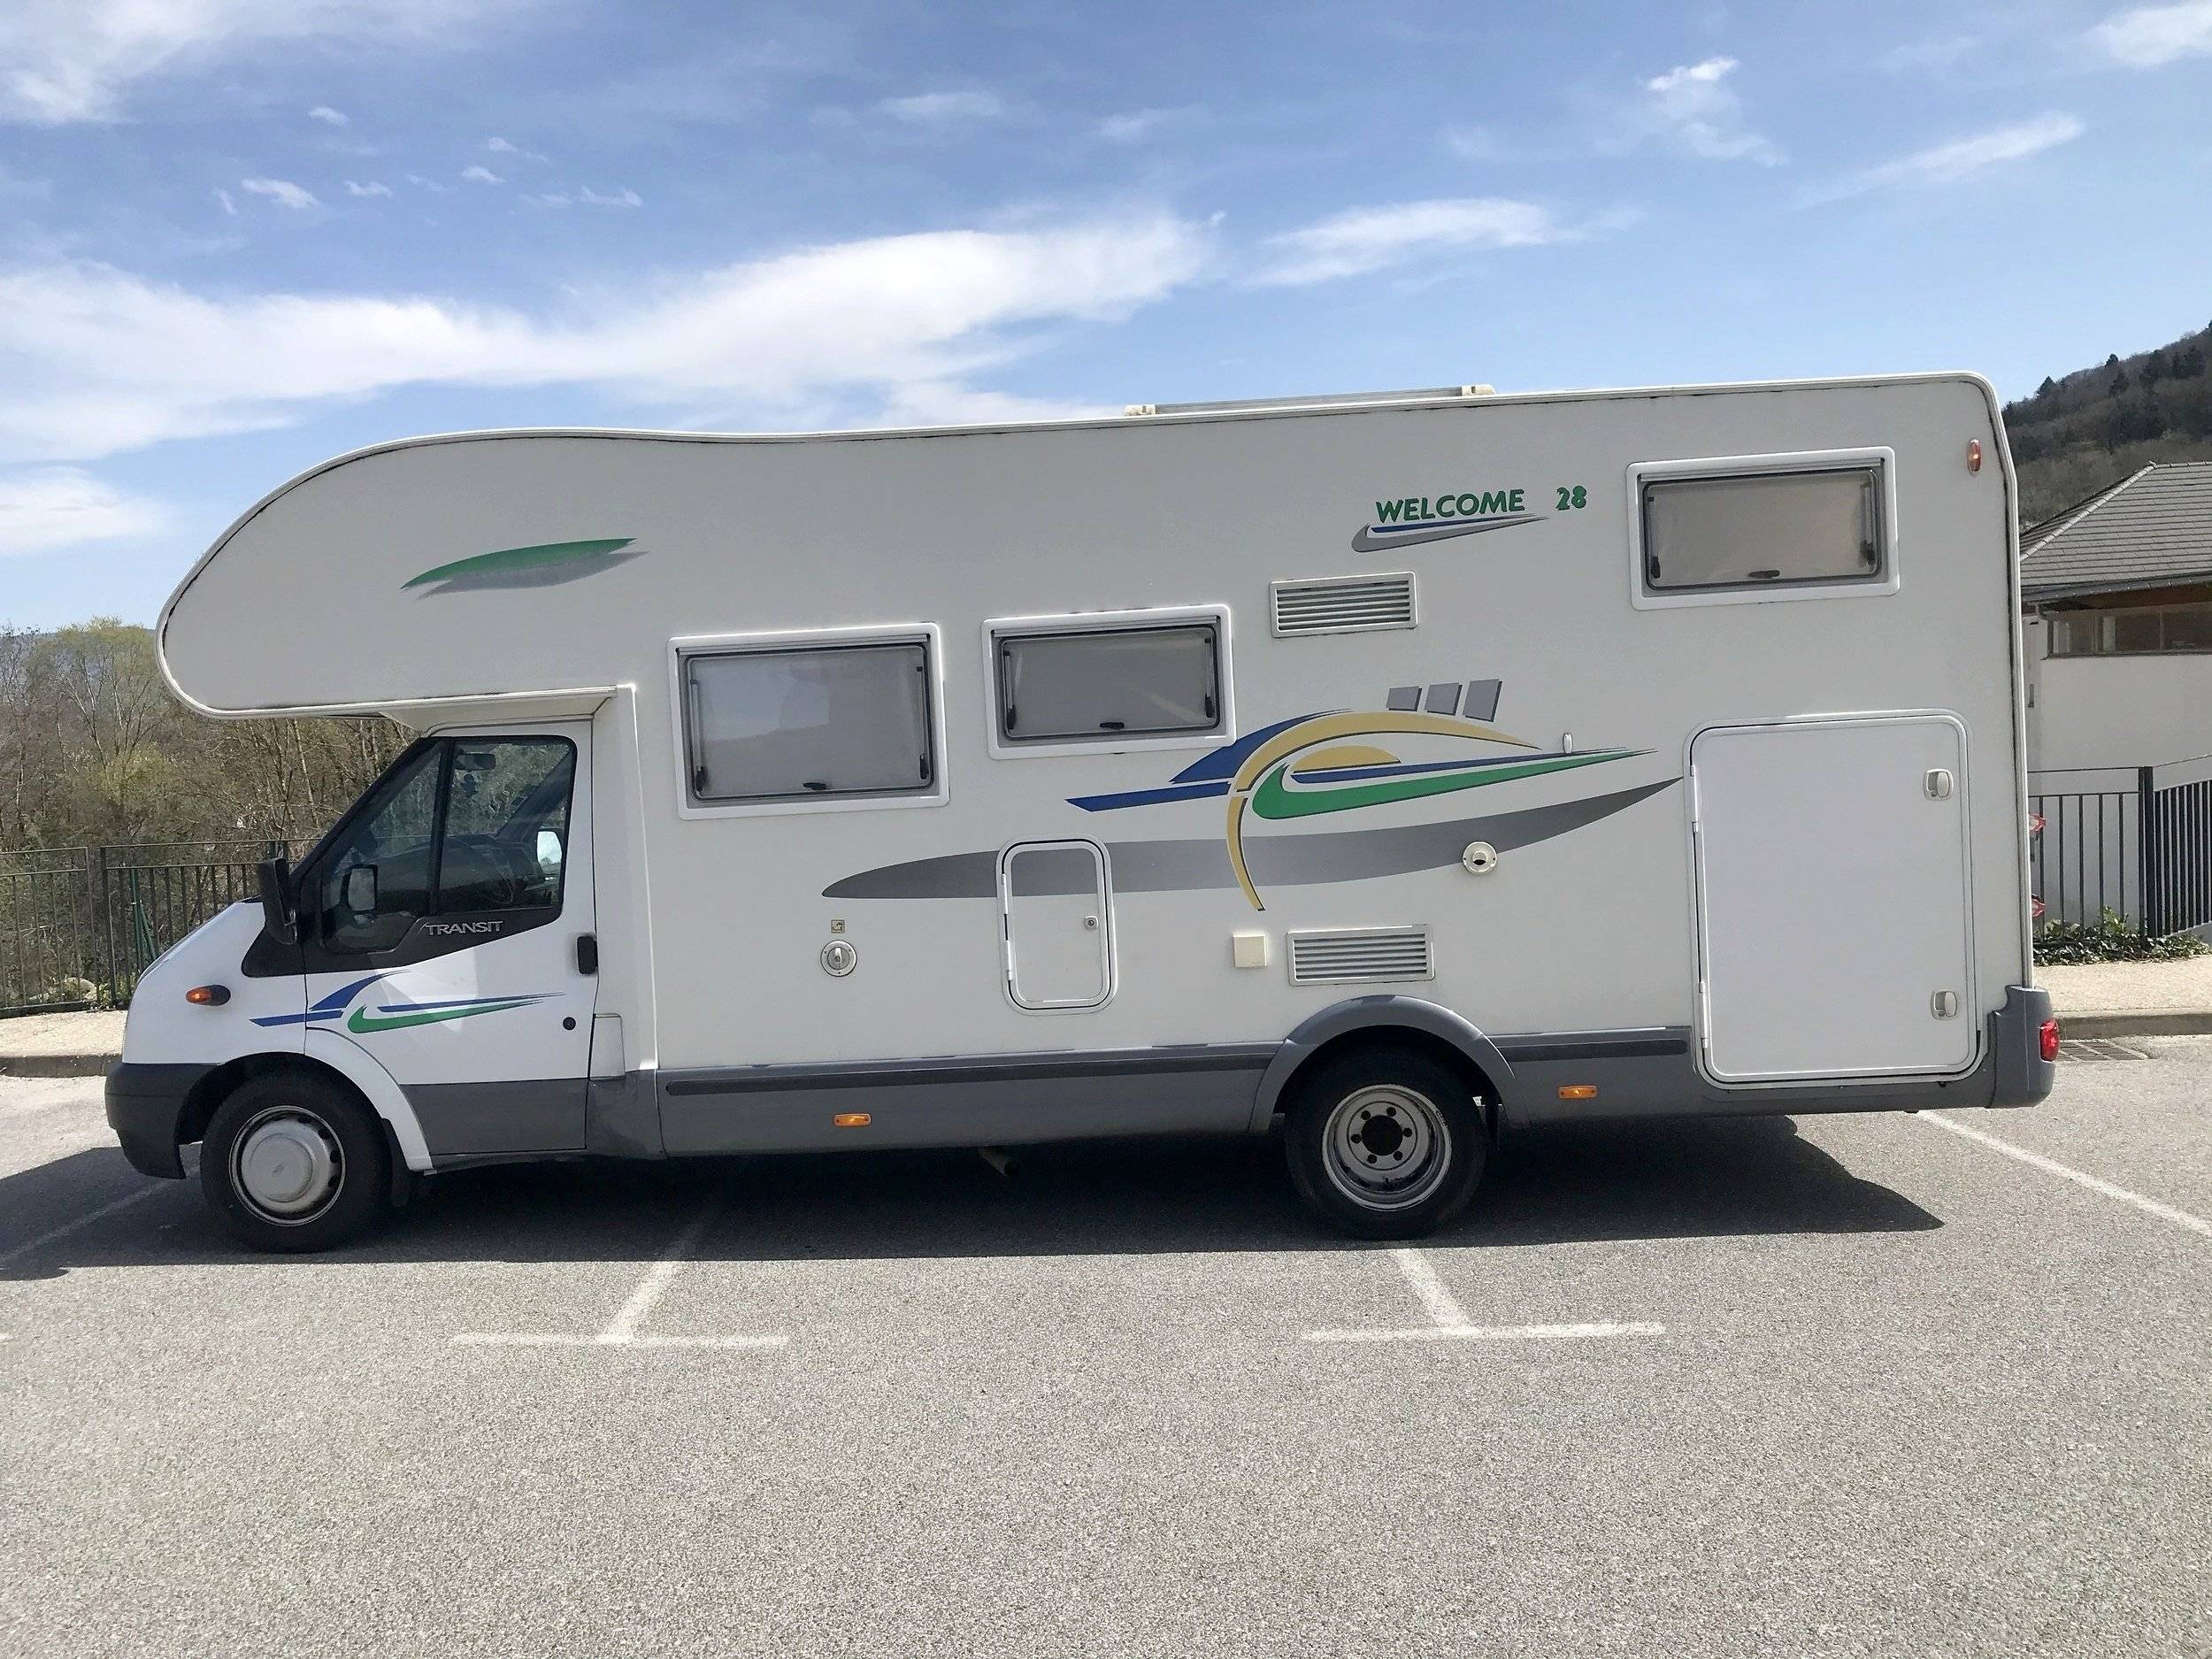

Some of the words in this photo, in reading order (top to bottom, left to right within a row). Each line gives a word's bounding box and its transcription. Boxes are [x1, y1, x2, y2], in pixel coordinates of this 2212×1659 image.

[1376, 488, 1525, 524] WELCOME
[1555, 486, 1587, 511] 28
[426, 921, 503, 935] TRANSIT
